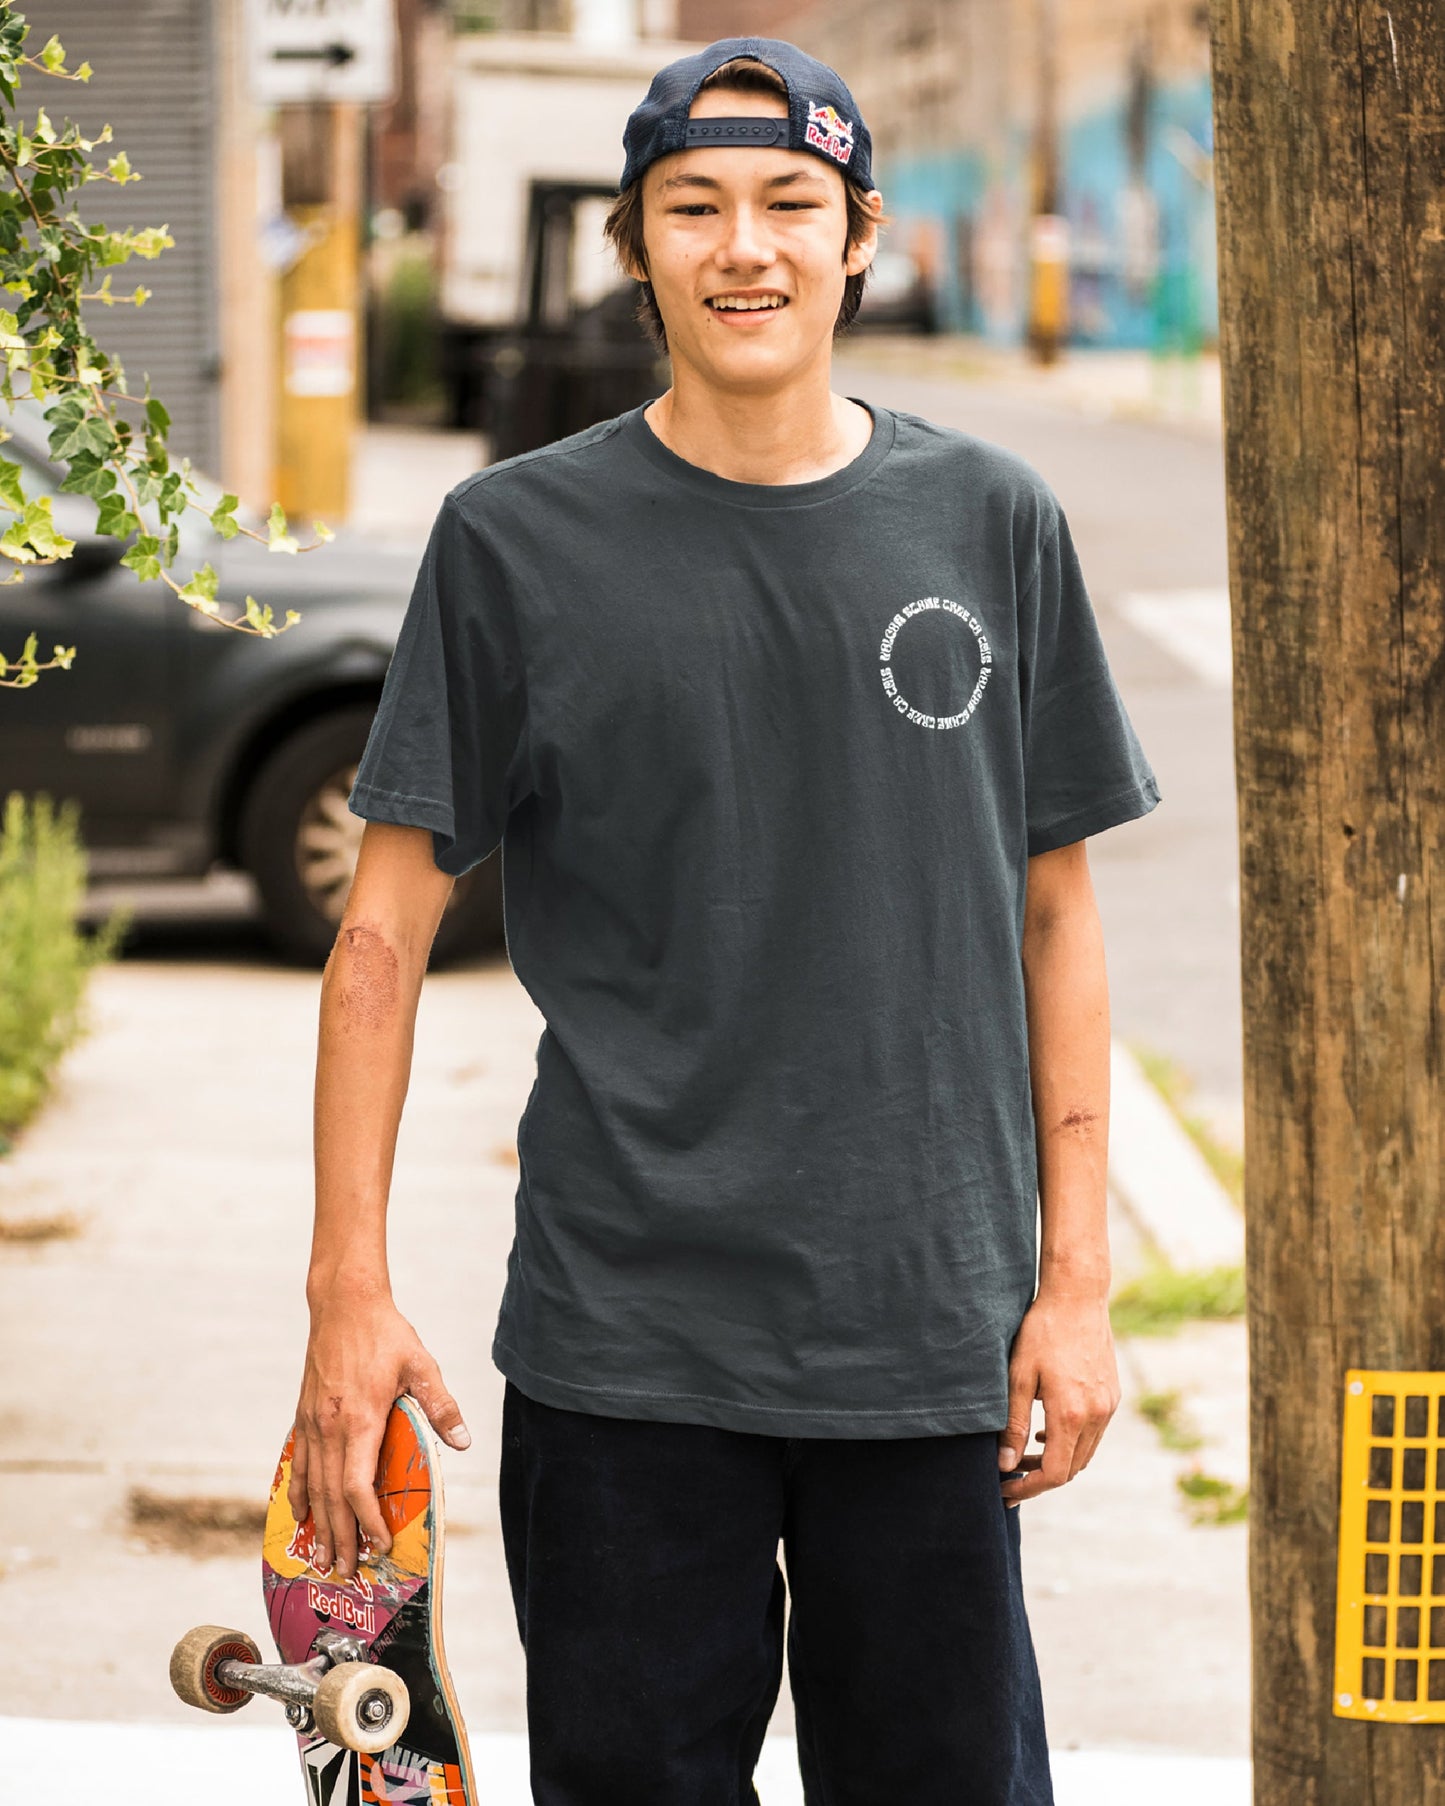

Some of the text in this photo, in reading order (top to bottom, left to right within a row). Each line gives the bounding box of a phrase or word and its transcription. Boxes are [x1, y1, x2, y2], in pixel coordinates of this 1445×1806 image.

[806, 123, 852, 163] Red Bull
[308, 1581, 375, 1634] Red Bull
[381, 1744, 443, 1789] NIKE
